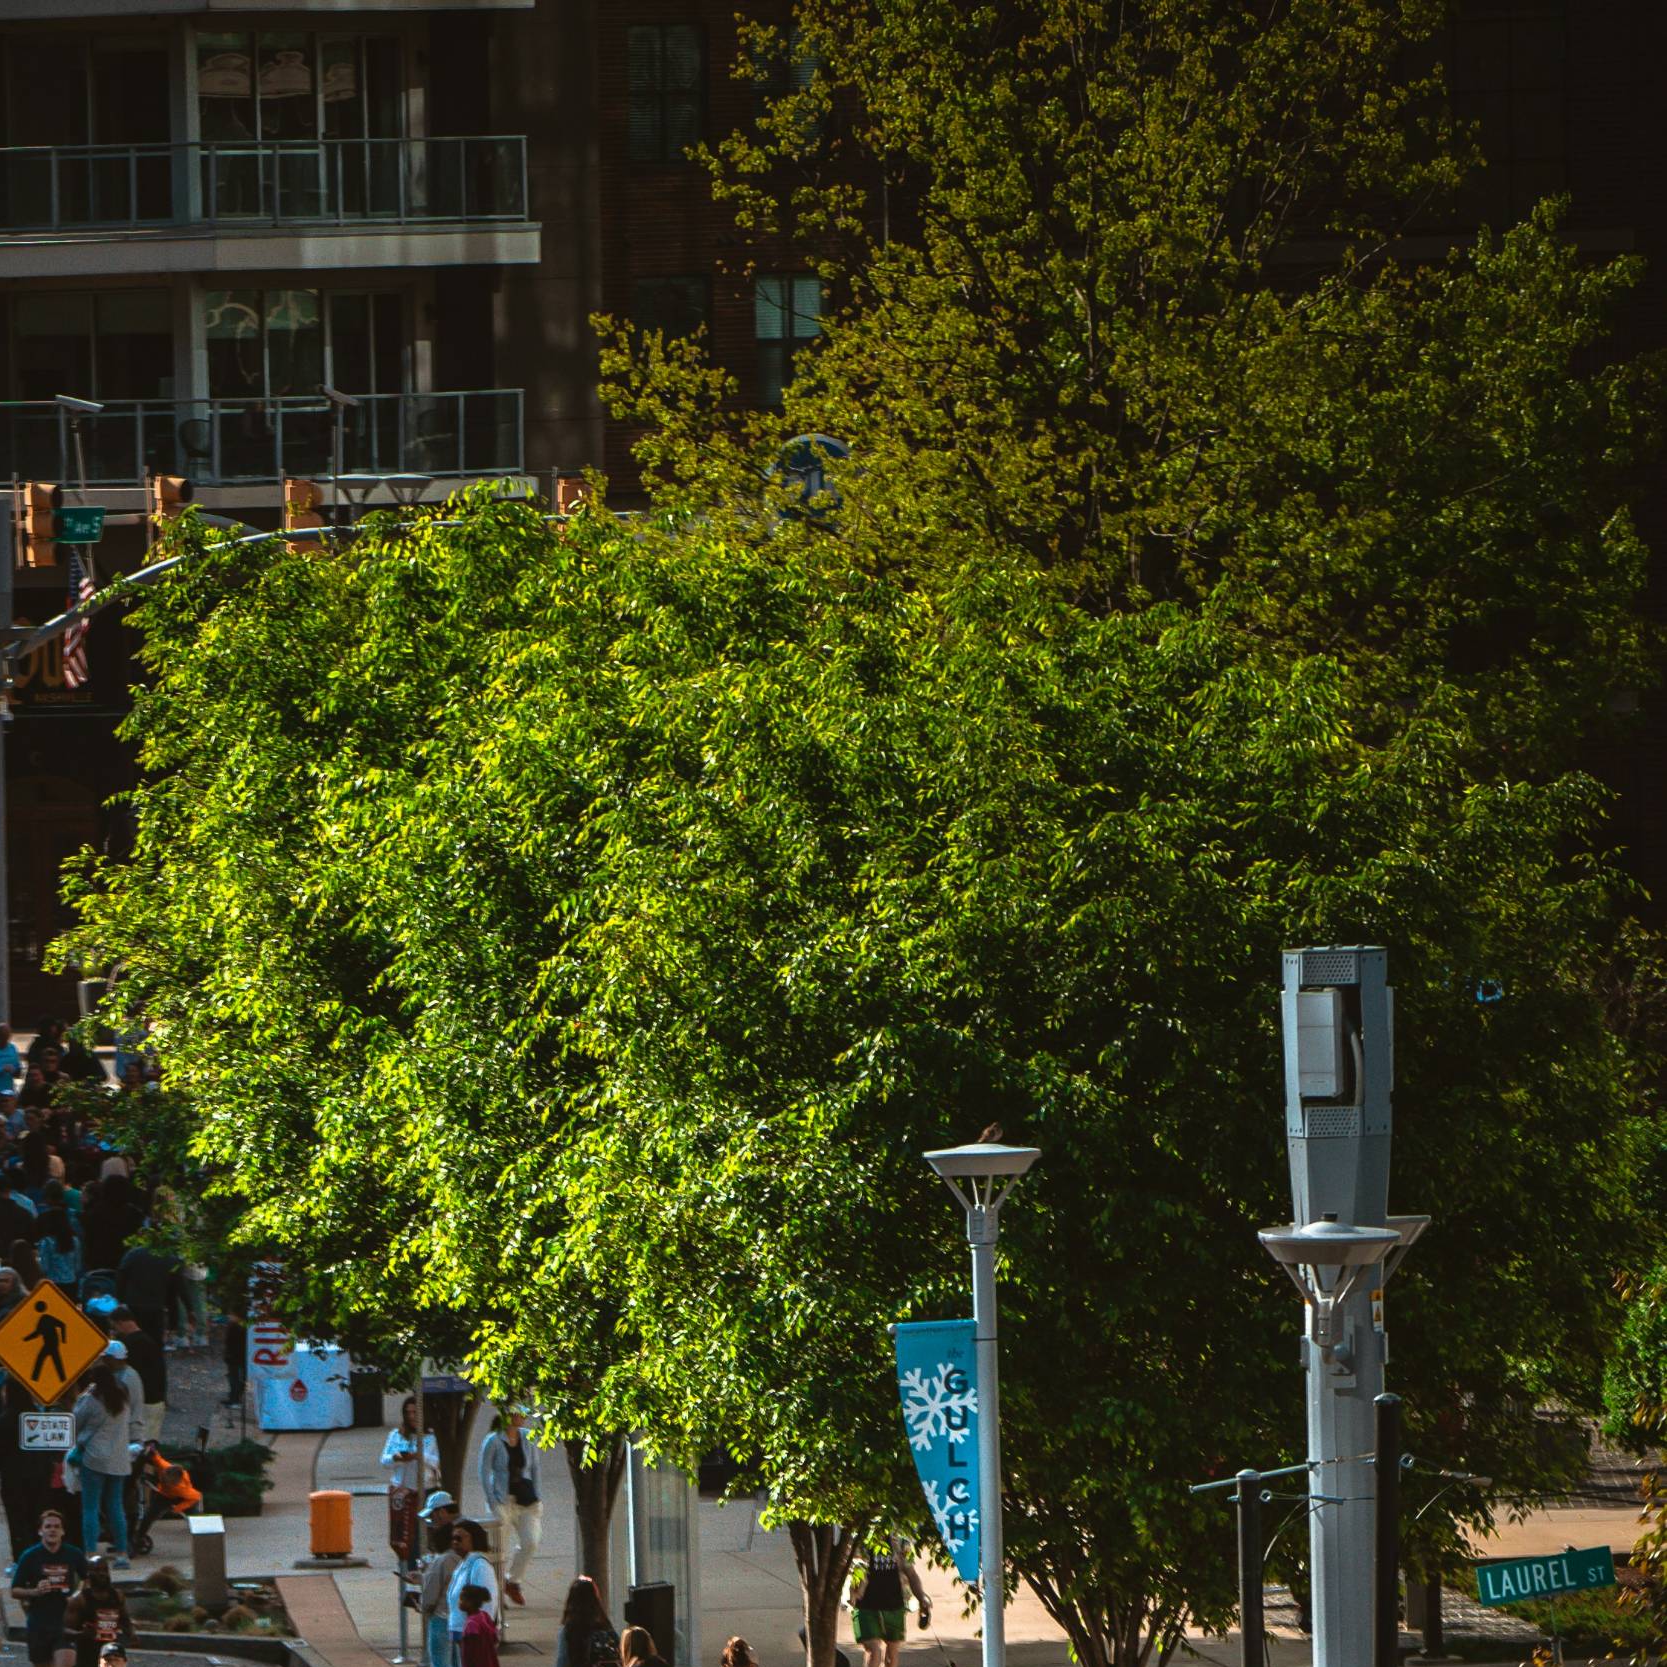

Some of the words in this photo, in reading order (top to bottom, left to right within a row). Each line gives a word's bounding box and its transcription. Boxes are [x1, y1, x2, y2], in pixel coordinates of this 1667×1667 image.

[41, 1421, 69, 1430] STATE
[43, 1433, 65, 1443] LAW
[944, 1370, 970, 1540] GULCH
[1485, 1559, 1578, 1600] LAUREL
[1587, 1566, 1606, 1584] ST
